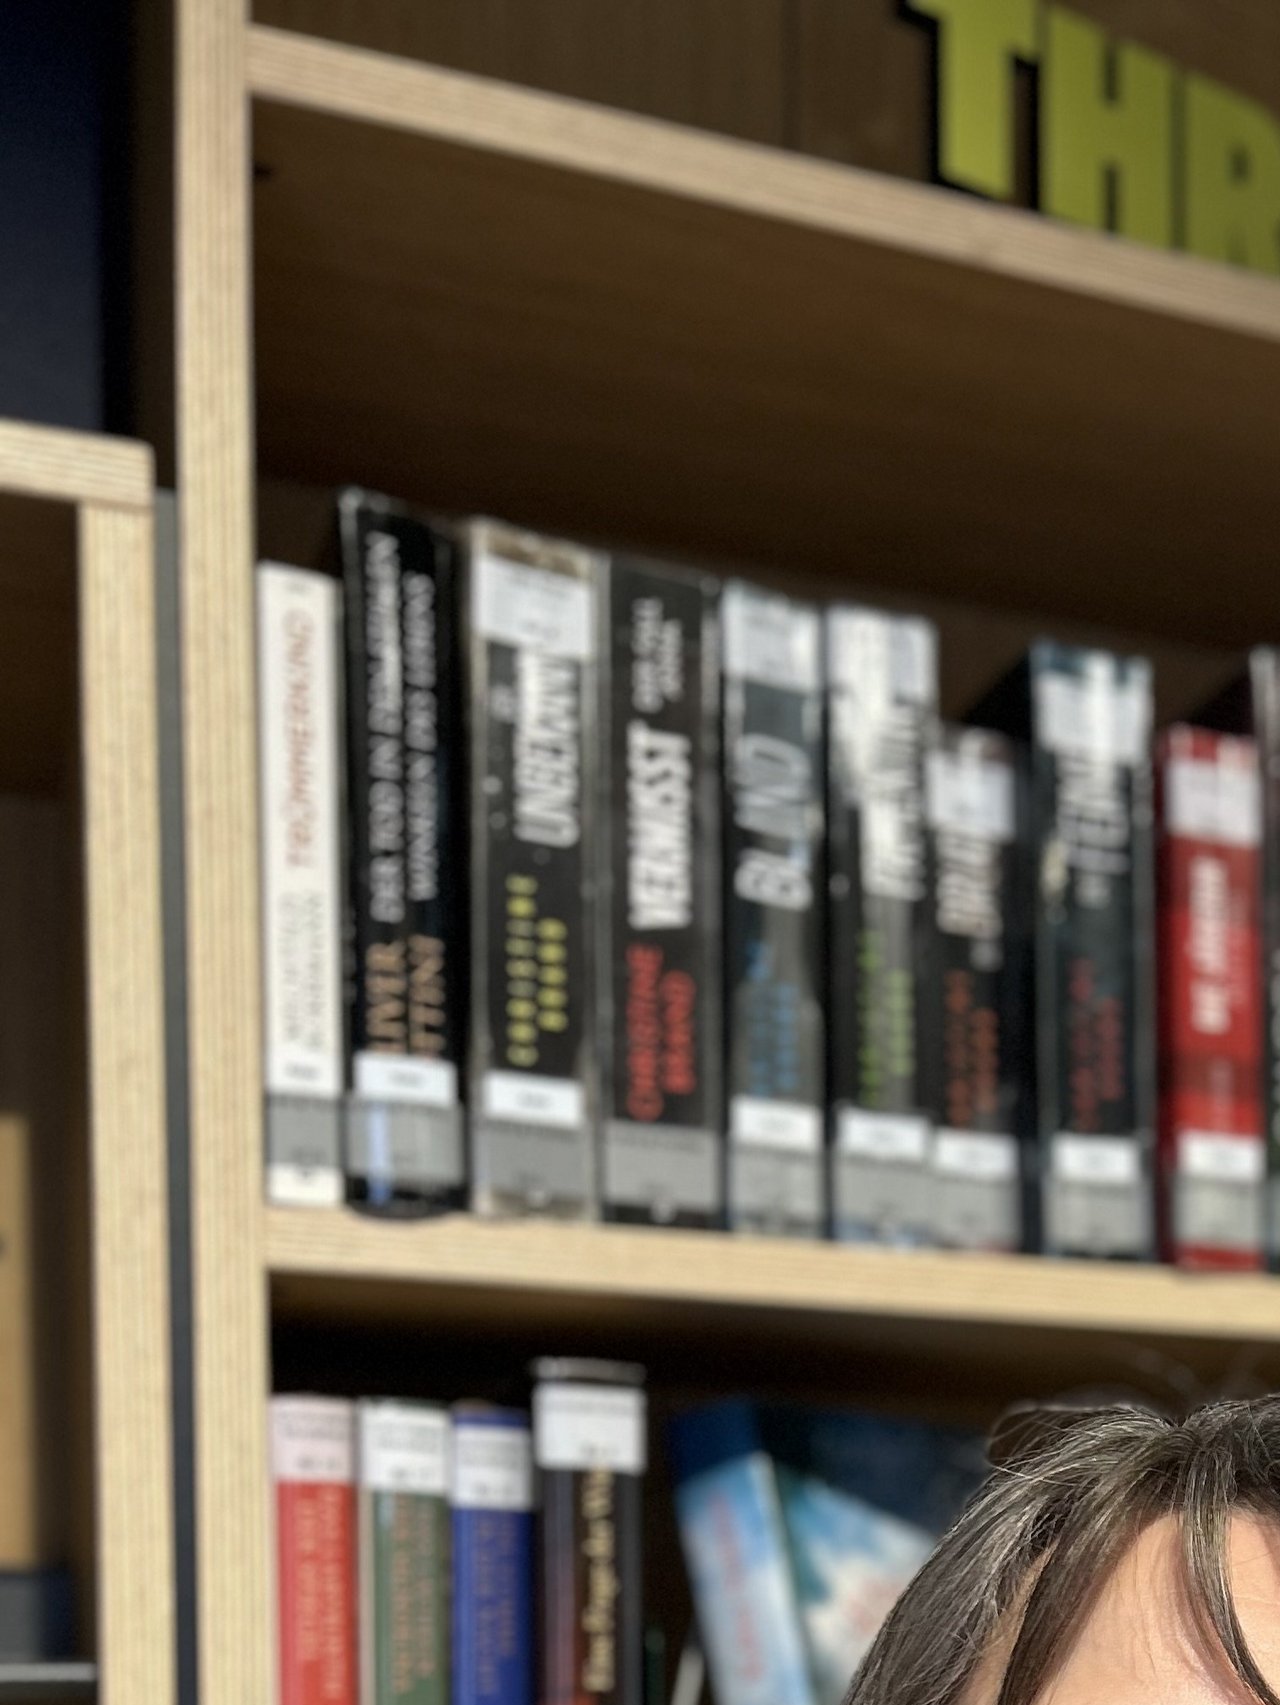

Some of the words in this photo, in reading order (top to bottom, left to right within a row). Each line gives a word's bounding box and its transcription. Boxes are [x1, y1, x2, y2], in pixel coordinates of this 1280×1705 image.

[627, 721, 691, 931] VERMISST
[732, 734, 813, 912] BLIND
[365, 940, 405, 1054] LIVER
[626, 945, 663, 1121] CHRISTINE
[662, 971, 696, 1094] BRAND
